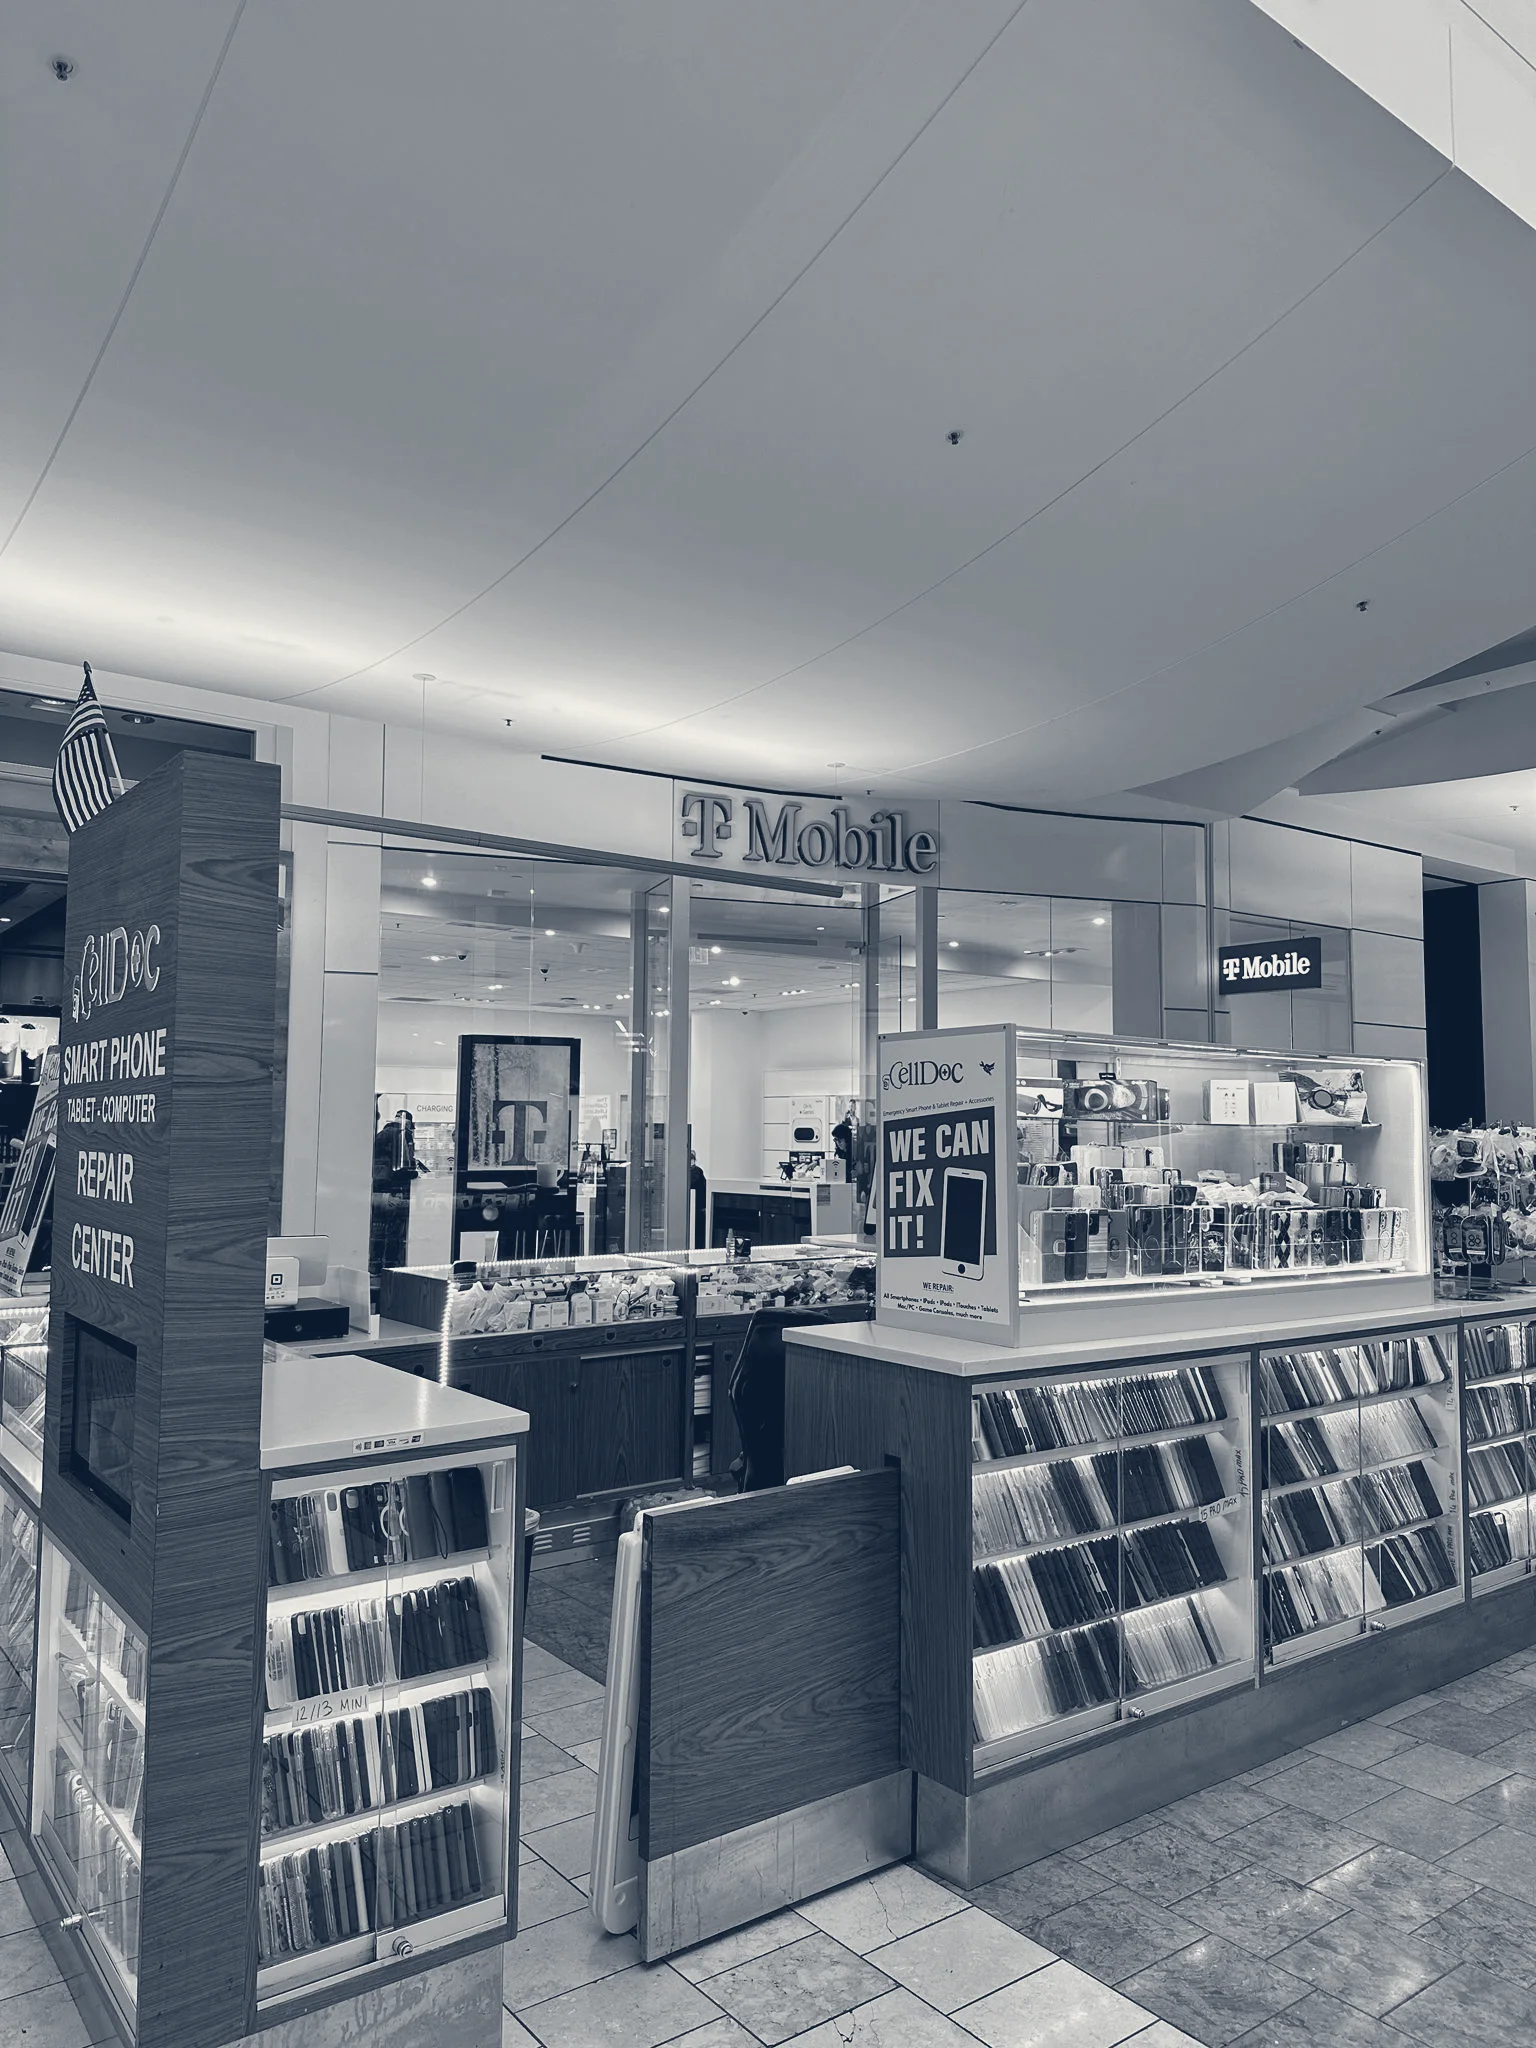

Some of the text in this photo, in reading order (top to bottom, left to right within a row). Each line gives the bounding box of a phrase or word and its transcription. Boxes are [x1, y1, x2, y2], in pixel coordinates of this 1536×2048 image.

[681, 794, 937, 874] T Mobile
[1223, 952, 1311, 981] T Mobile
[64, 1028, 167, 1086] SMART PHONE
[882, 1060, 964, 1091] CellDoc
[29, 1105, 49, 1143] WE
[67, 1098, 96, 1123] TABLET
[101, 1094, 156, 1123] COMPUTER
[883, 1109, 905, 1117] Emergency
[950, 1099, 963, 1108] Repair
[889, 1119, 989, 1163] WE CAN
[15, 1140, 42, 1189] FIX
[77, 1151, 134, 1204] REPAIR
[889, 1168, 935, 1209] FIX
[1, 1186, 26, 1234] IT!
[889, 1215, 924, 1250] IT!
[72, 1222, 134, 1288] CENTER
[890, 1294, 919, 1303] Smartphones
[980, 1305, 999, 1313] Tablets
[922, 1282, 932, 1290] WE
[1200, 1508, 1209, 1521] 15
[1209, 1503, 1221, 1516] PRO
[296, 1695, 368, 1721] 12/13 MINI
